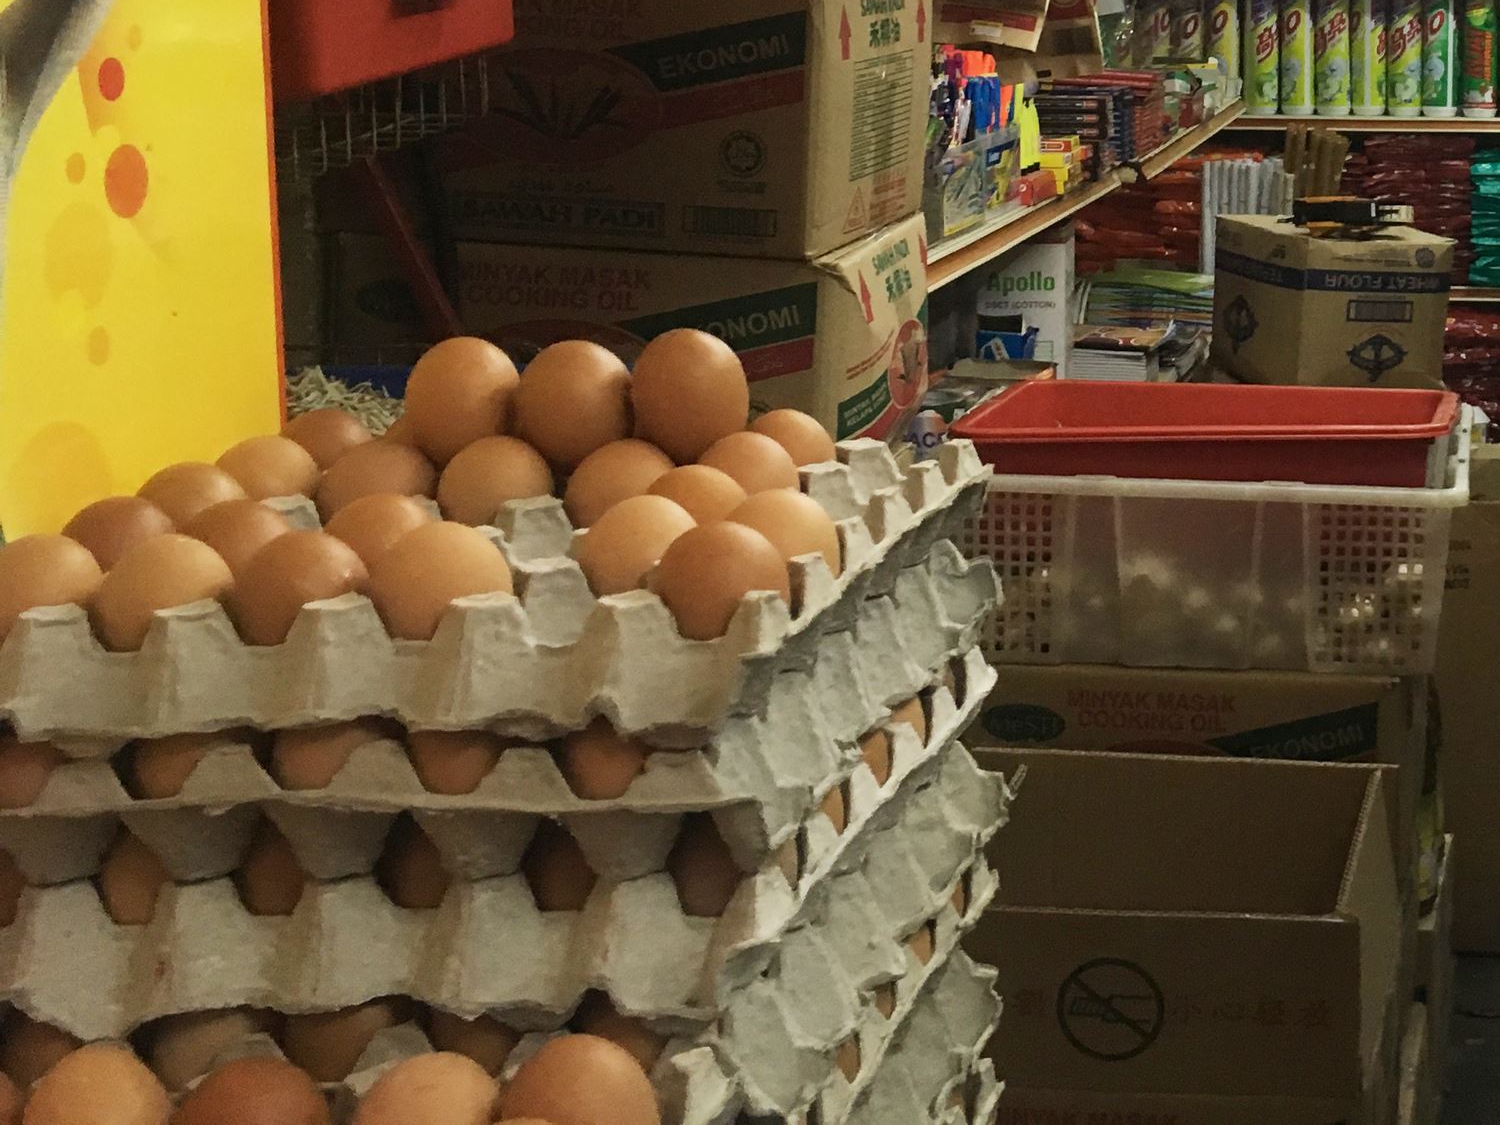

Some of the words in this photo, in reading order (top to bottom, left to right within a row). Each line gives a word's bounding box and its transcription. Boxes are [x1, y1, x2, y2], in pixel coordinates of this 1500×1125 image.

[656, 33, 790, 79] EKONOMI
[558, 263, 651, 290] MASAK
[987, 271, 1056, 297] Apollo
[1324, 274, 1383, 289] FLOUR
[465, 285, 588, 310] COOKING
[596, 288, 640, 312] OIL
[704, 304, 800, 342] ONOMI
[1067, 688, 1151, 713] MINYAK
[1155, 690, 1237, 714] MASAK
[1077, 710, 1185, 731] COOKING
[1190, 712, 1228, 732] OIL
